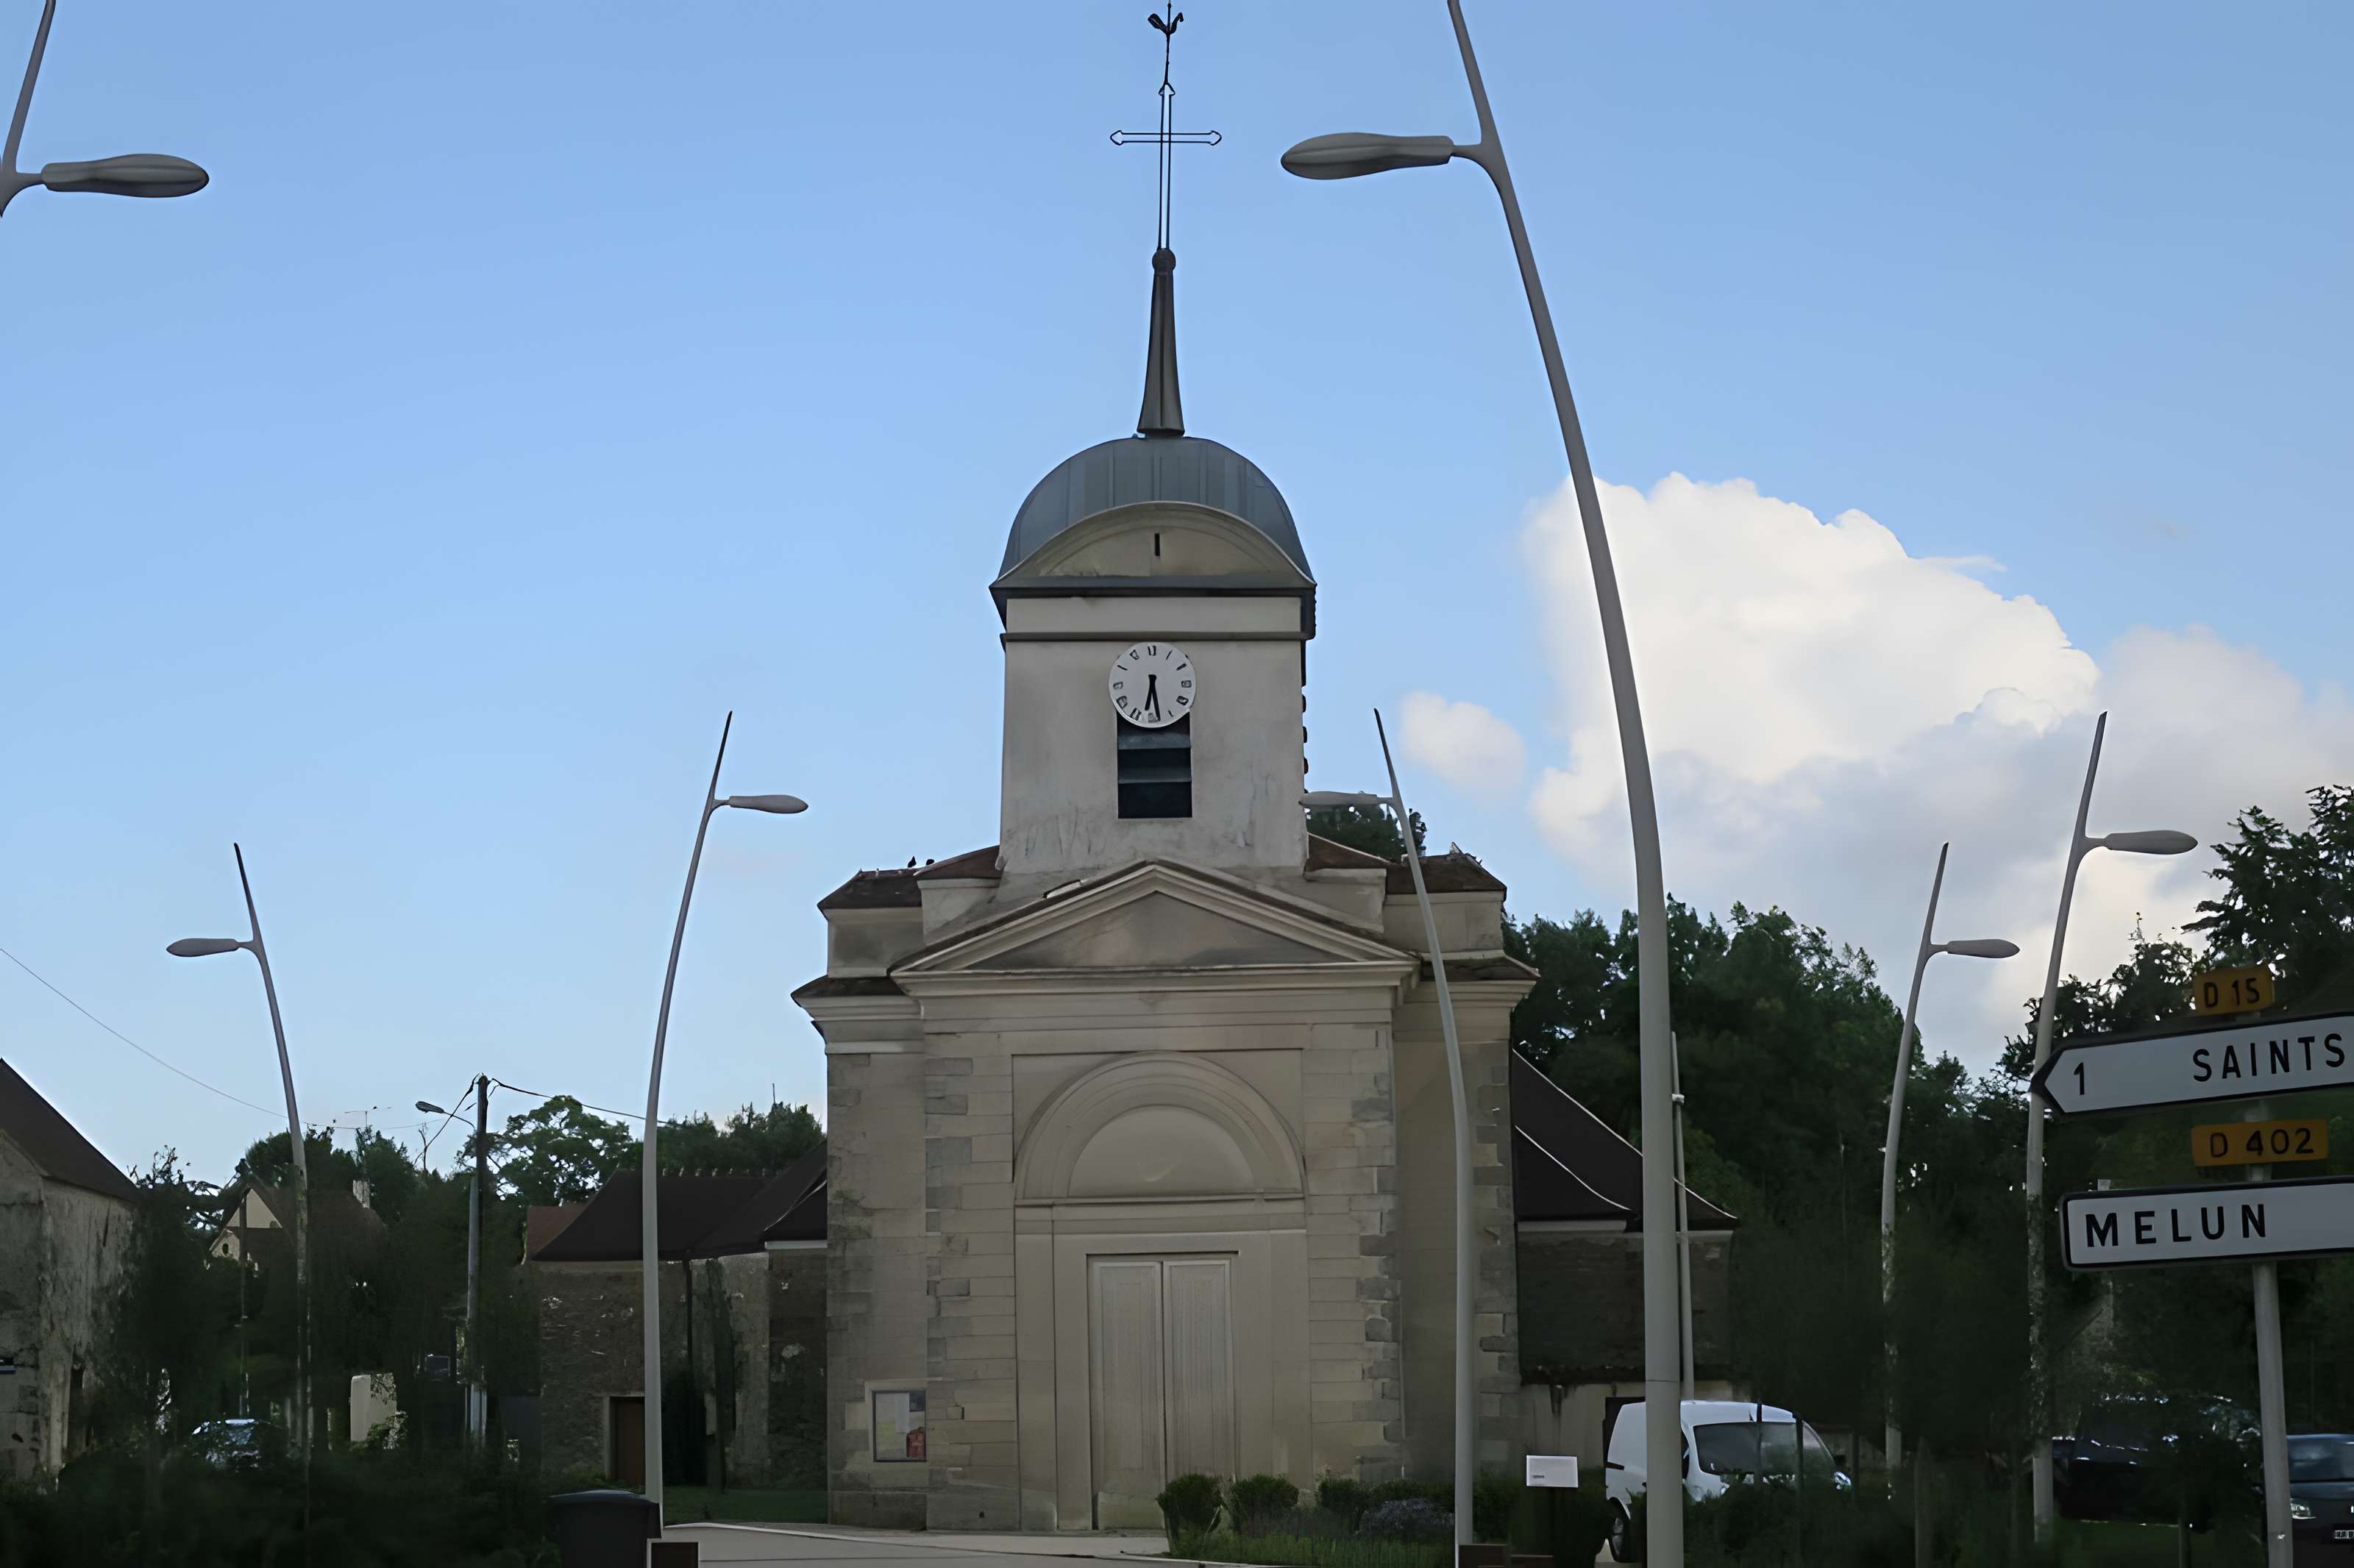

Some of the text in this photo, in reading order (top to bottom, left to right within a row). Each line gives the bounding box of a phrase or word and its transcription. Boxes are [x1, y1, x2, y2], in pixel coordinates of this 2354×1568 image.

[2203, 978, 2261, 1008] D 15
[2074, 1033, 2345, 1095] 1 SAINTS
[2211, 1128, 2314, 1158] D 402
[2085, 1204, 2266, 1247] MELUN
